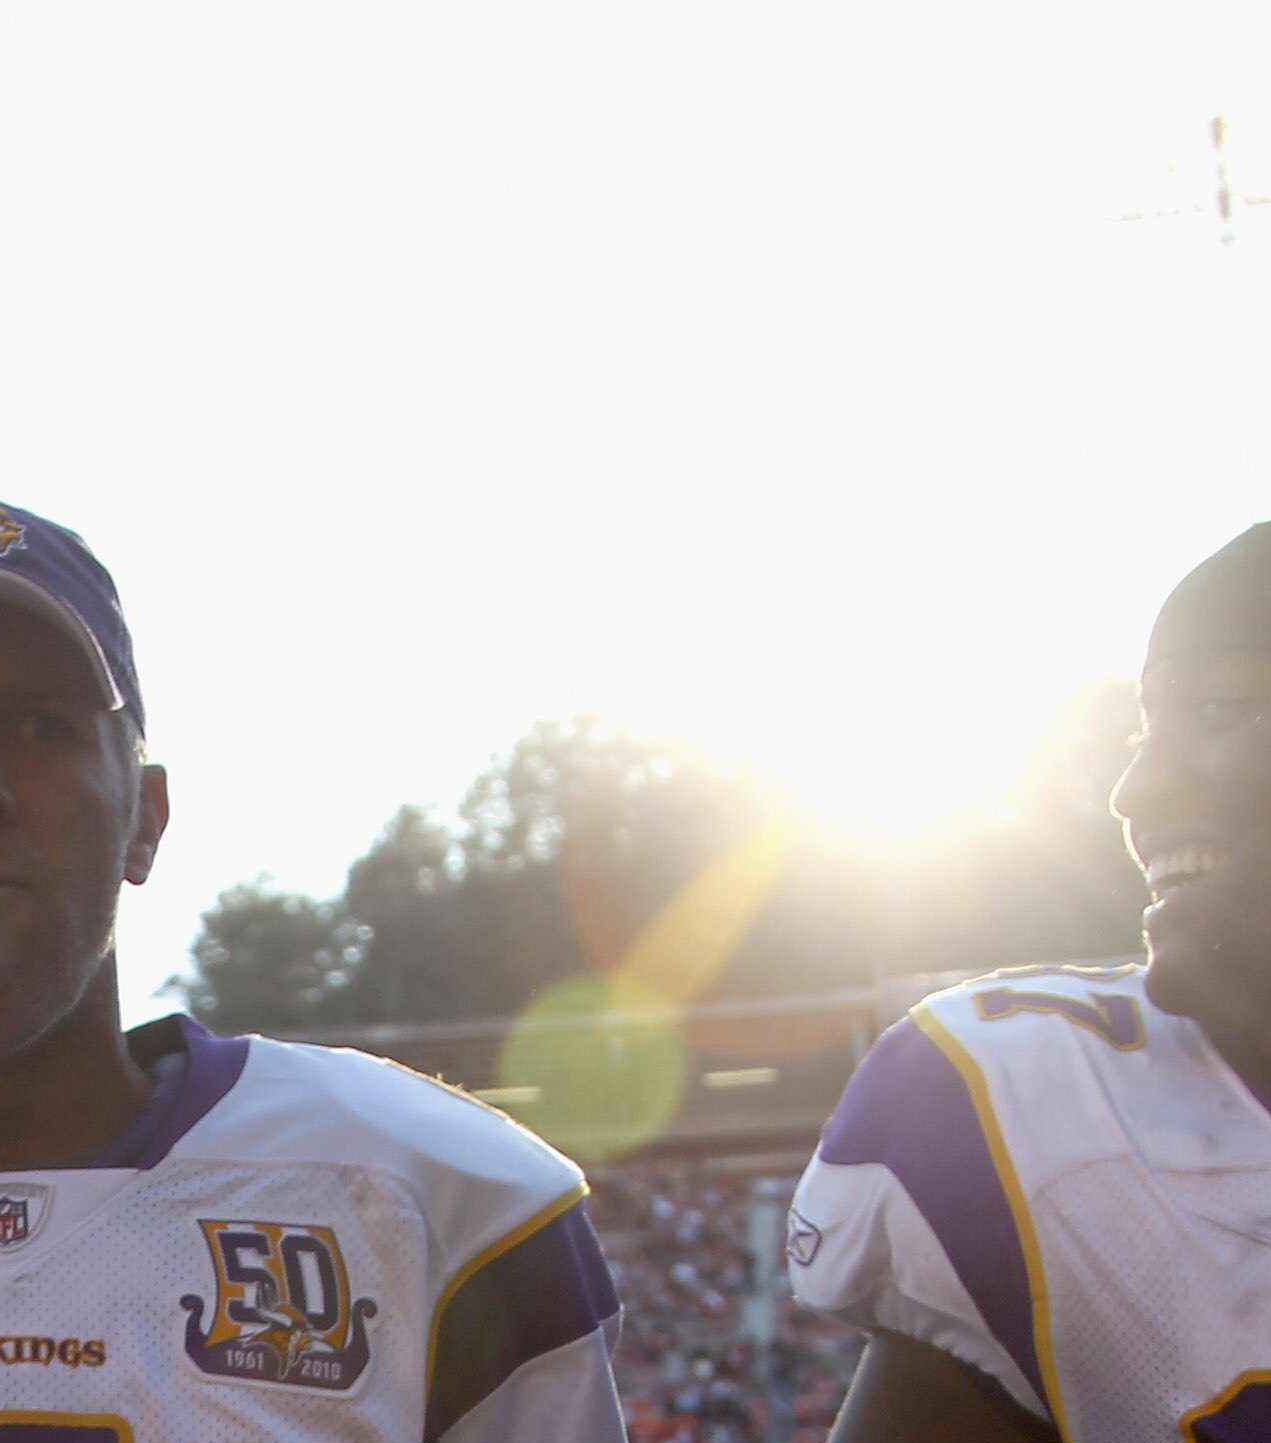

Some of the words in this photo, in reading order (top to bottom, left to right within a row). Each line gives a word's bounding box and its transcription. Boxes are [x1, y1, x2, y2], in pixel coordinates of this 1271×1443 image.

[217, 1231, 340, 1332] 50
[226, 1350, 265, 1371] 1961
[301, 1359, 342, 1381] 2010
